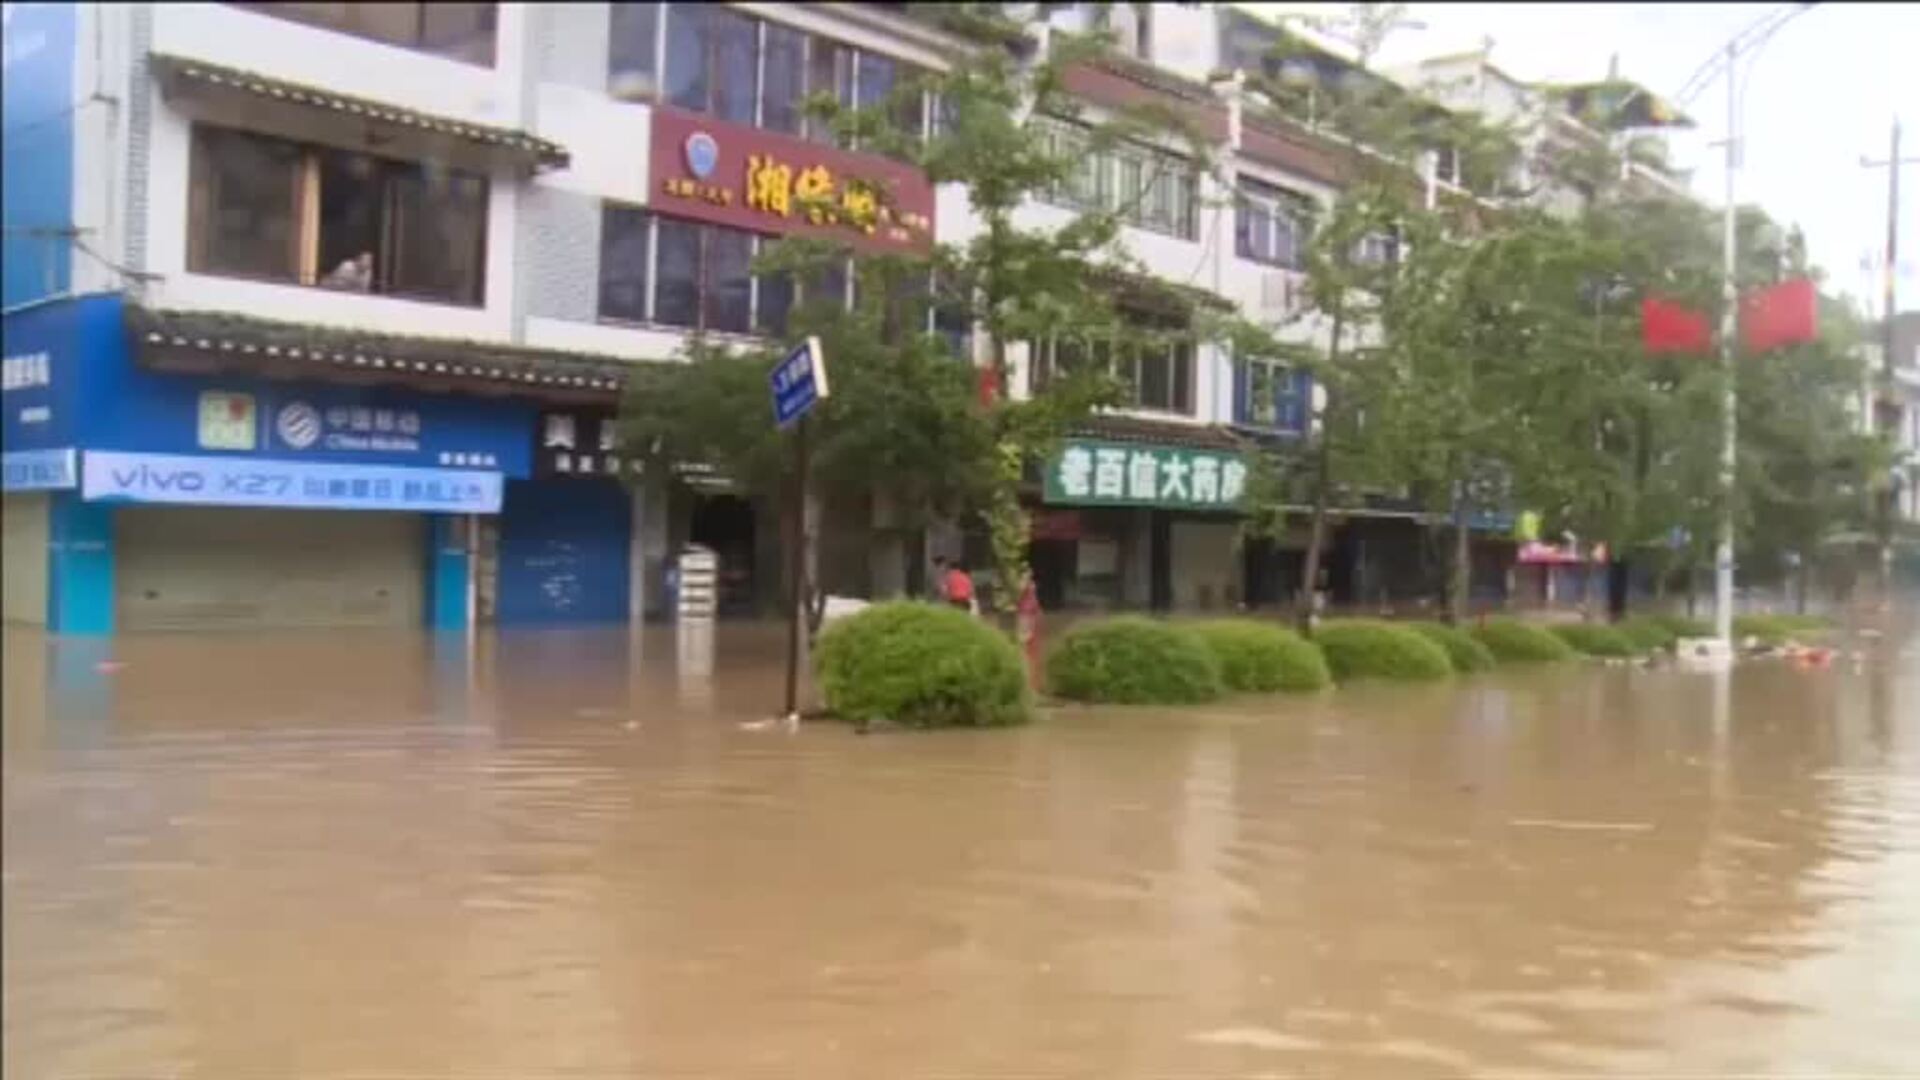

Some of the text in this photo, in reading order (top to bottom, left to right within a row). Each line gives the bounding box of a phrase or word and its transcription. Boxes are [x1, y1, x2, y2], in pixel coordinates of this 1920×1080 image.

[111, 463, 205, 492] vivo
[221, 471, 293, 496] X27
[1059, 446, 1247, 503] 老百信大药房
